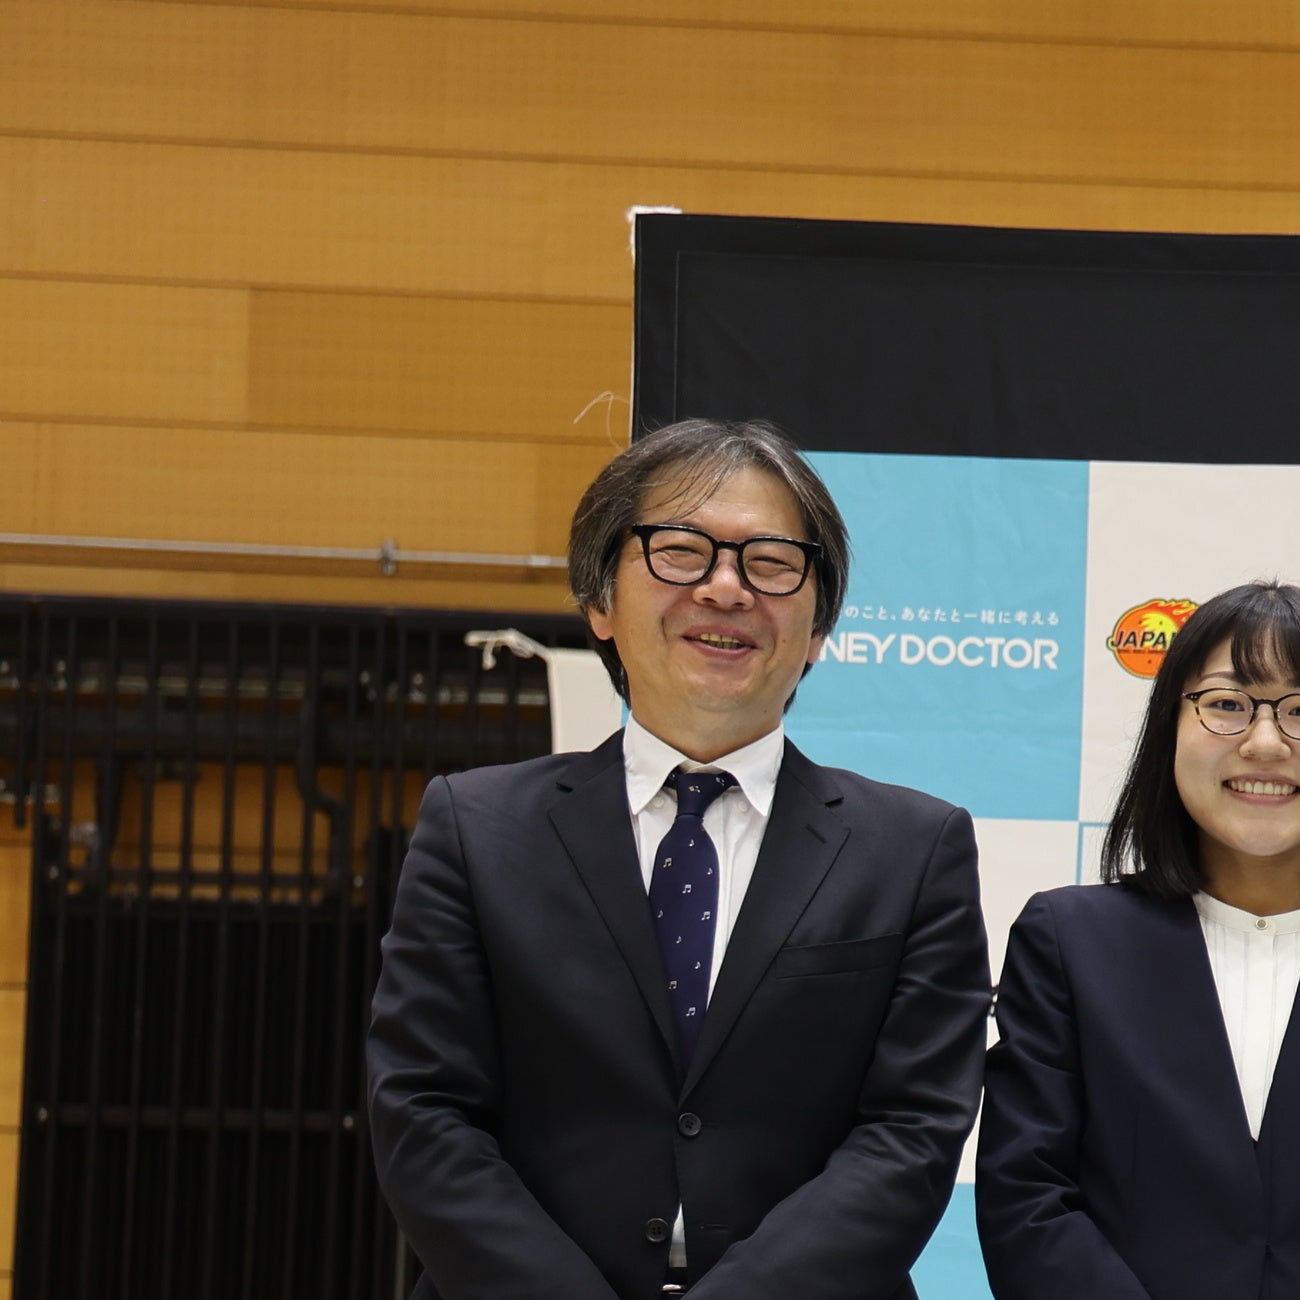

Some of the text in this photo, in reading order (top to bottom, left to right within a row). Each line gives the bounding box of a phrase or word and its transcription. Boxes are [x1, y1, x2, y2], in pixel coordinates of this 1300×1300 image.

[842, 605, 1061, 627] のこと、あなたと一緒に考える
[1110, 630, 1177, 648] JAPA
[818, 630, 1060, 671] NEY DOCTOR
